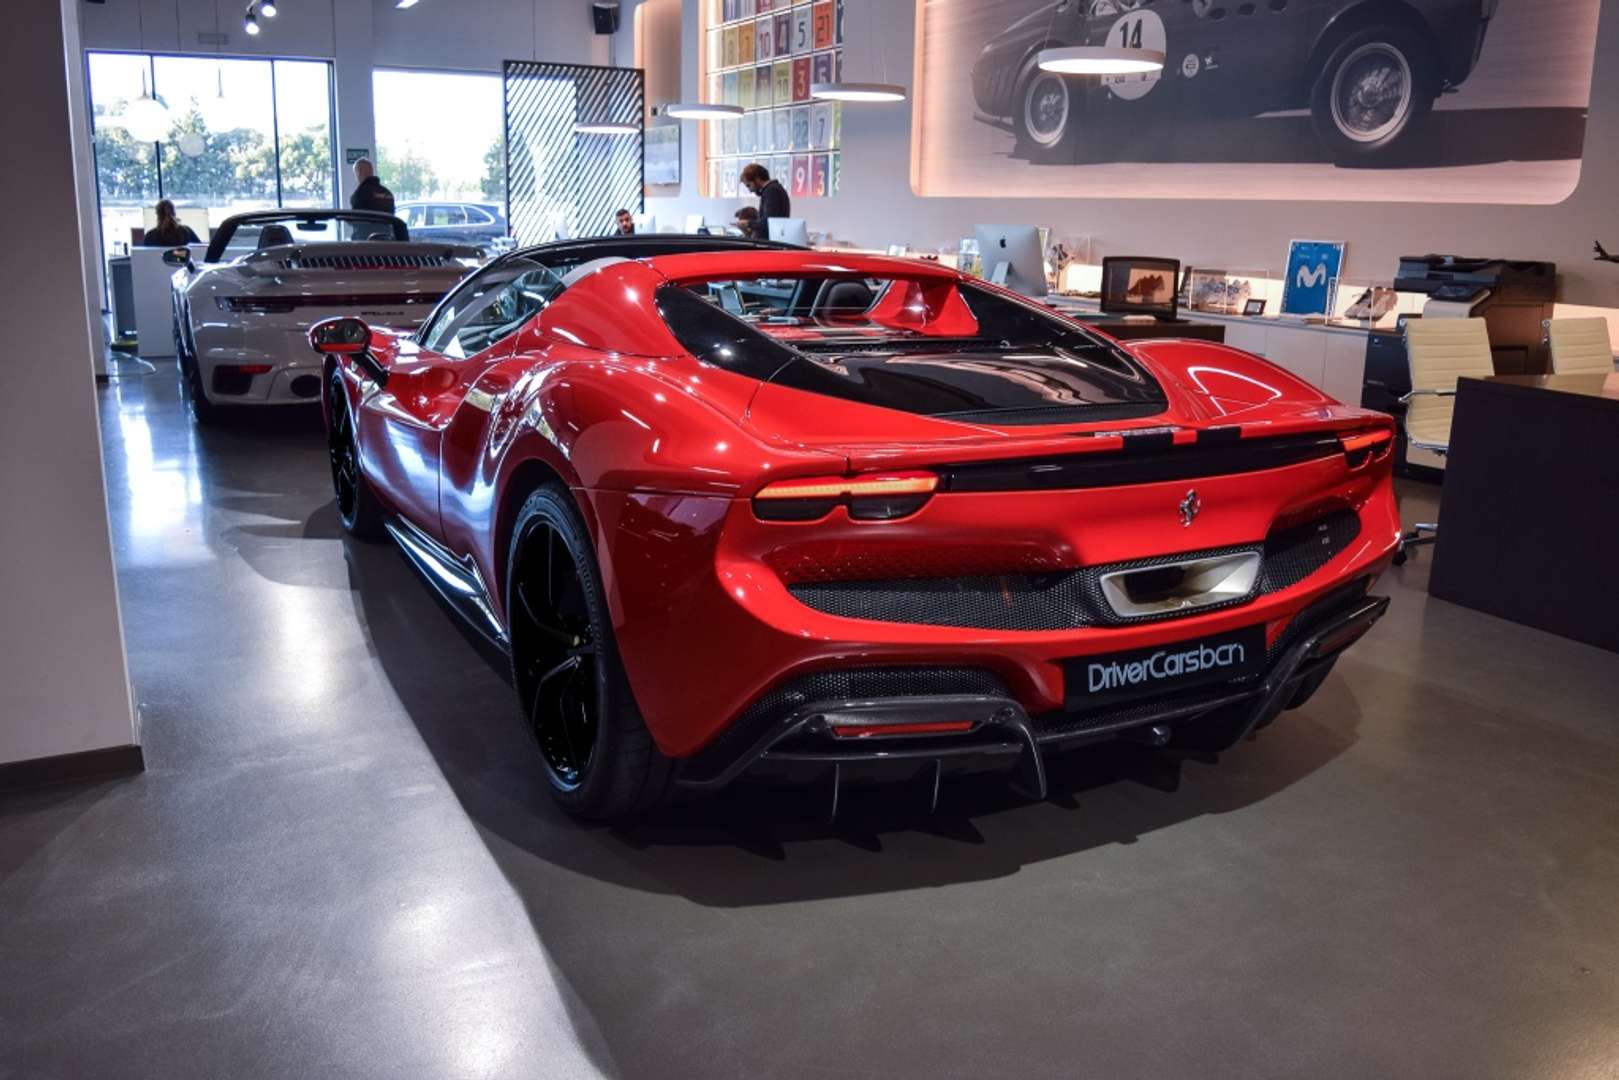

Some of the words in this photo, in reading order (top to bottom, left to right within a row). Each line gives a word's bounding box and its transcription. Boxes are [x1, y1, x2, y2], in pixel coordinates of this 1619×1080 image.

[798, 21, 806, 48] 5
[1120, 19, 1143, 49] 14
[796, 167, 806, 193] 9
[1088, 643, 1245, 693] DriverCarsbcn
